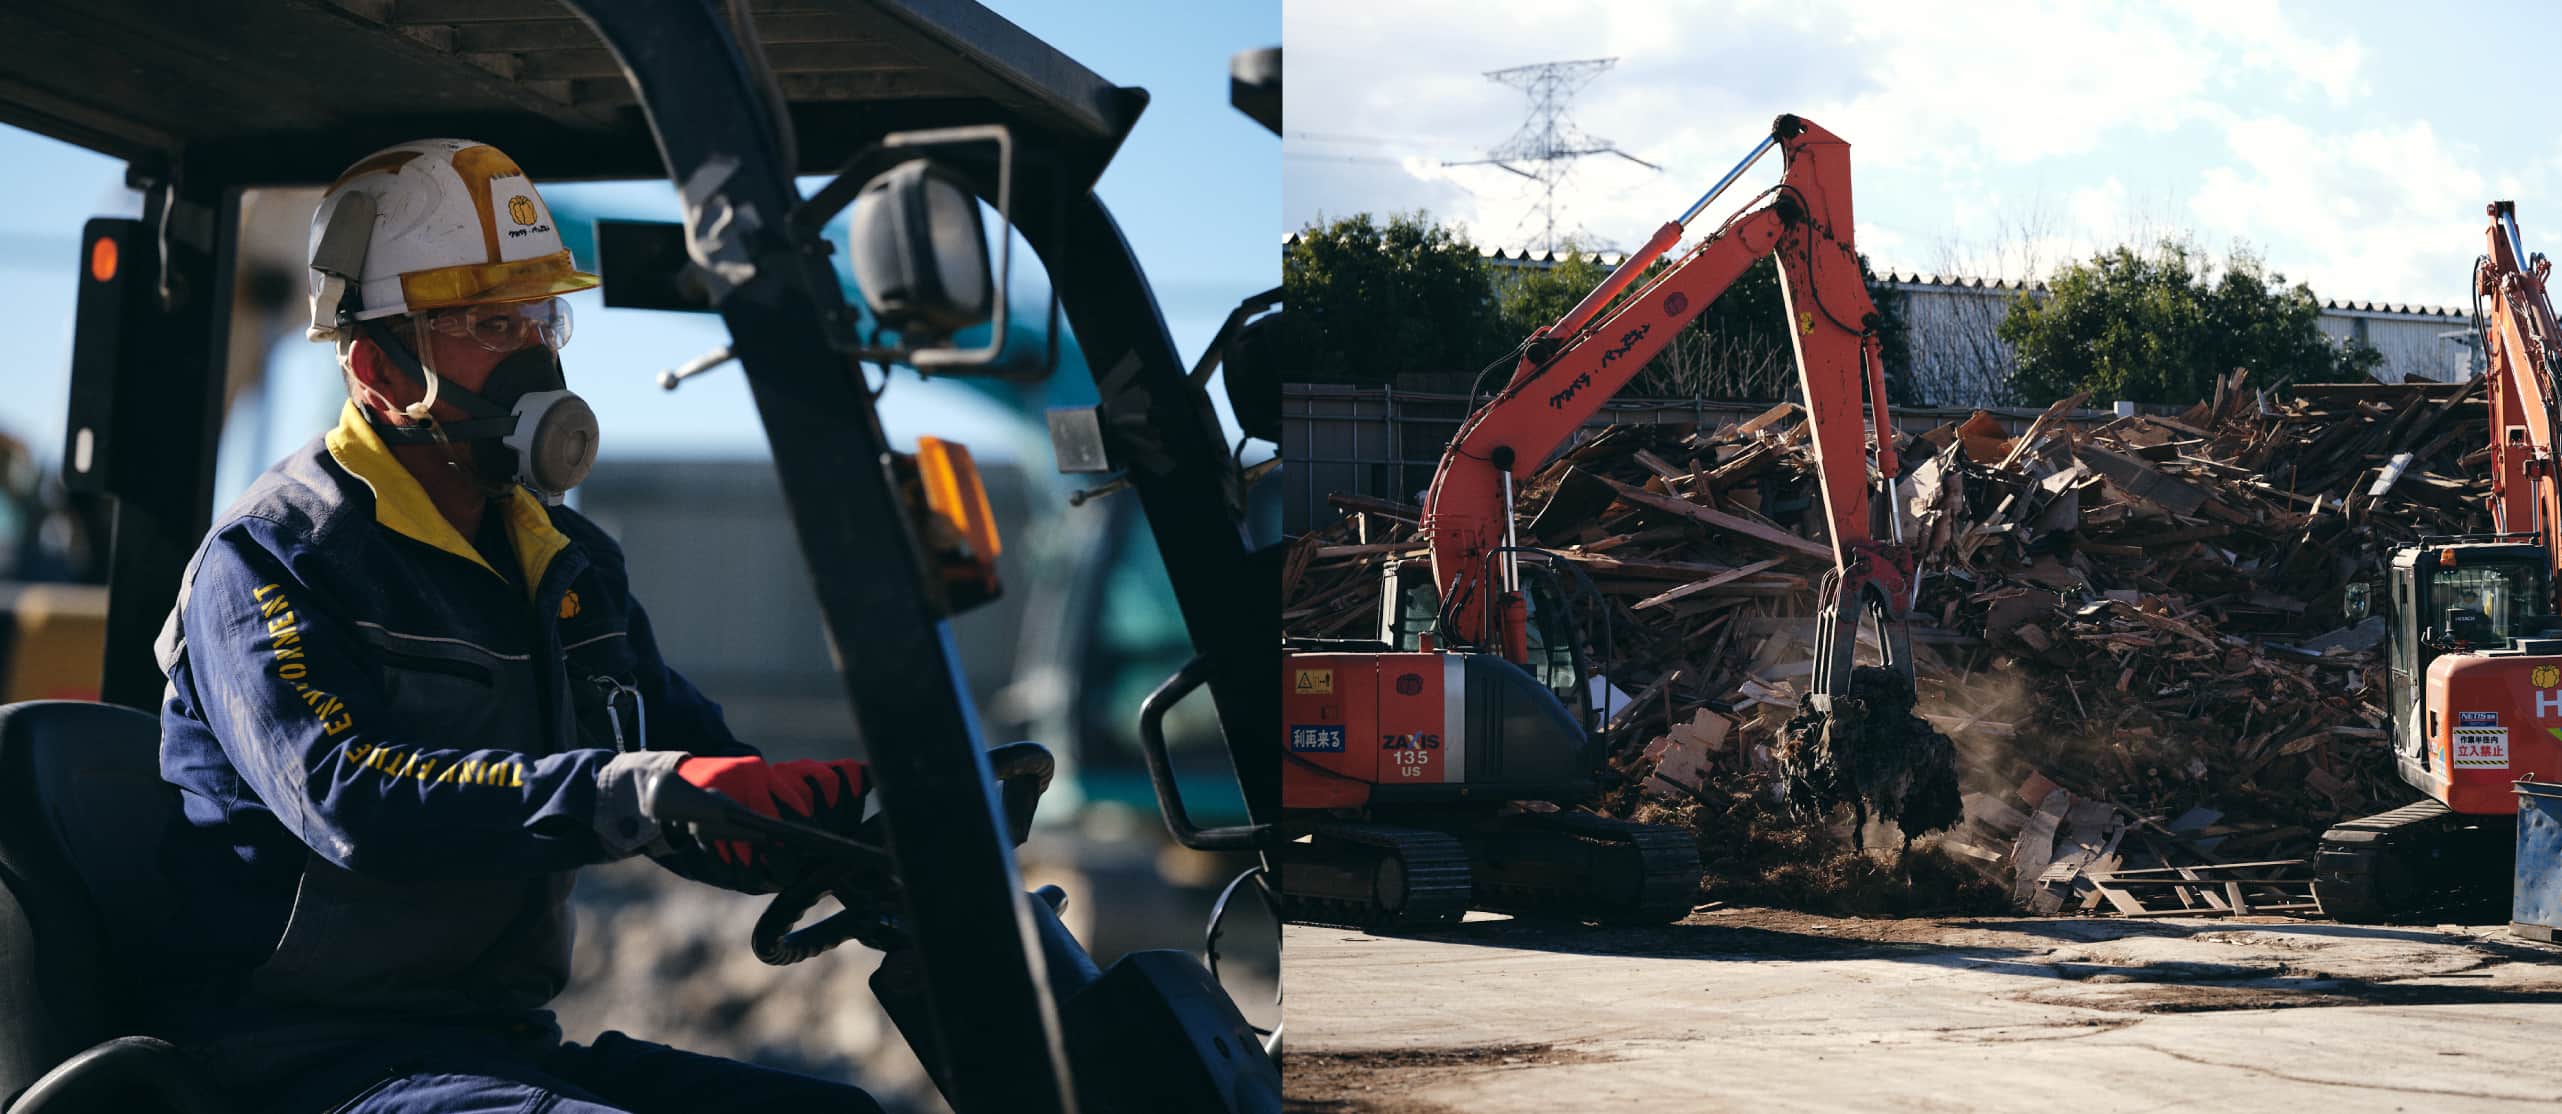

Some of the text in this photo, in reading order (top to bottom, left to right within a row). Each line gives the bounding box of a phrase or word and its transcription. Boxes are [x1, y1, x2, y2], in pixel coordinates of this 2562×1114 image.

[1382, 730, 1440, 750] ZAXIS
[2458, 745, 2504, 757] 立入禁止
[1393, 751, 1428, 765] 135
[1401, 766, 1421, 777] US
